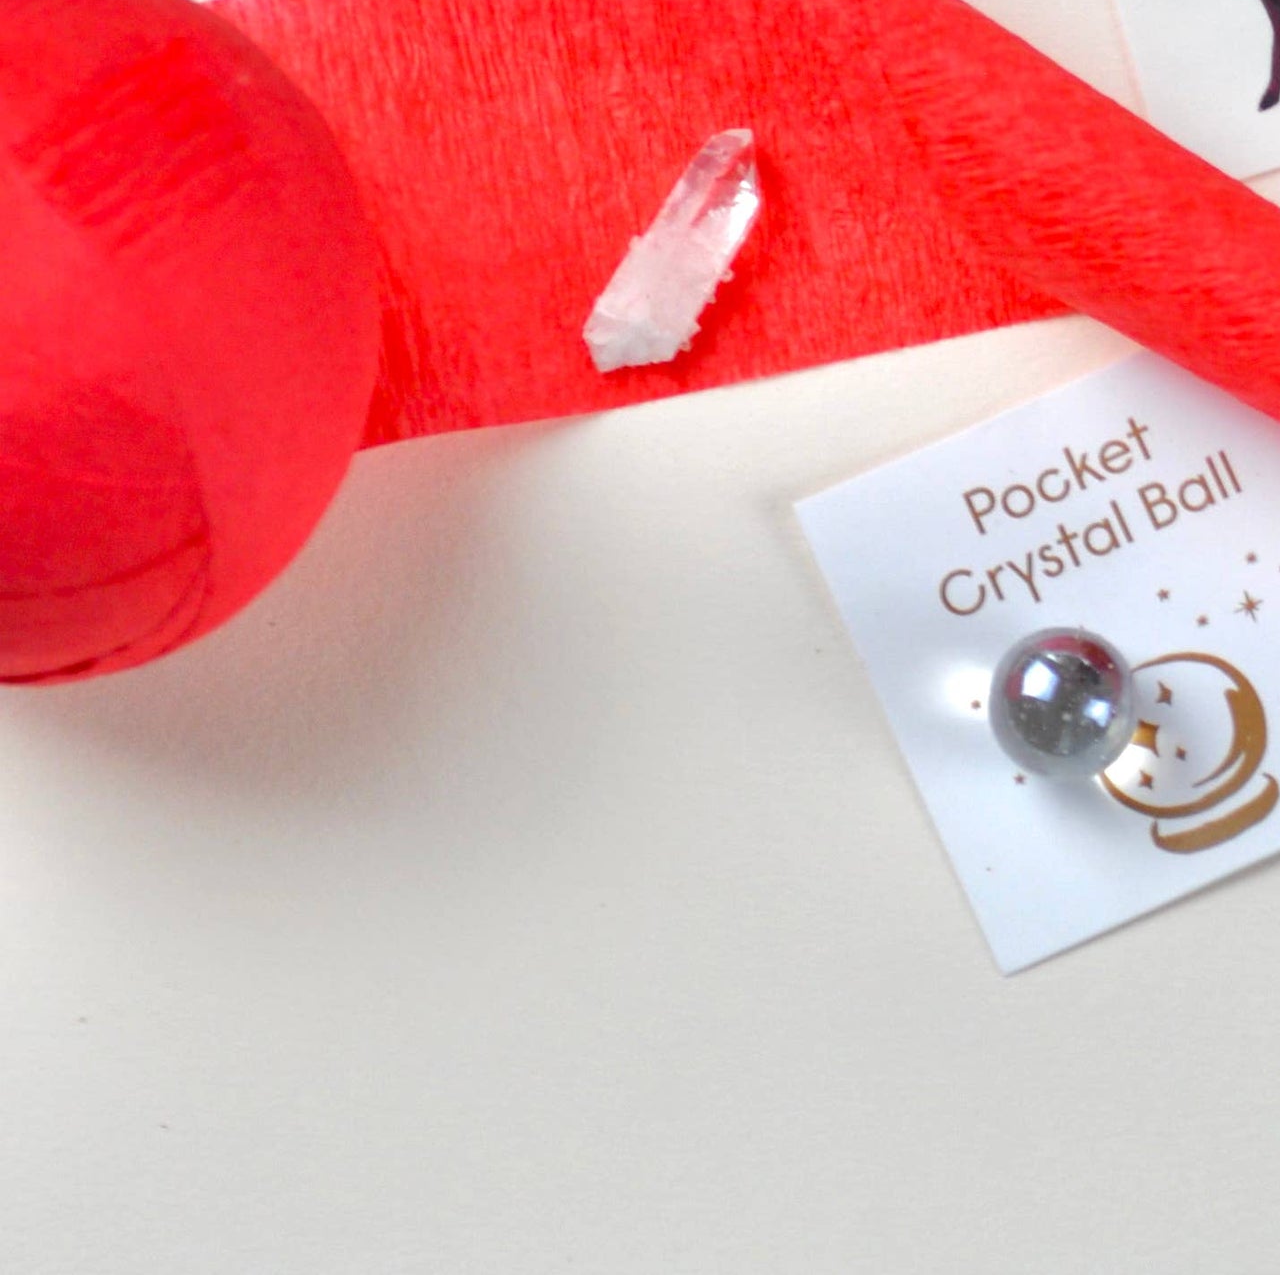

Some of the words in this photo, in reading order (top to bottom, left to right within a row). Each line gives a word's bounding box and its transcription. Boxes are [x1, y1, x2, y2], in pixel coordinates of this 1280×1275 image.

[939, 501, 1133, 616] Crystal
[1138, 450, 1242, 531] Ball
[963, 418, 1153, 533] Pocket
